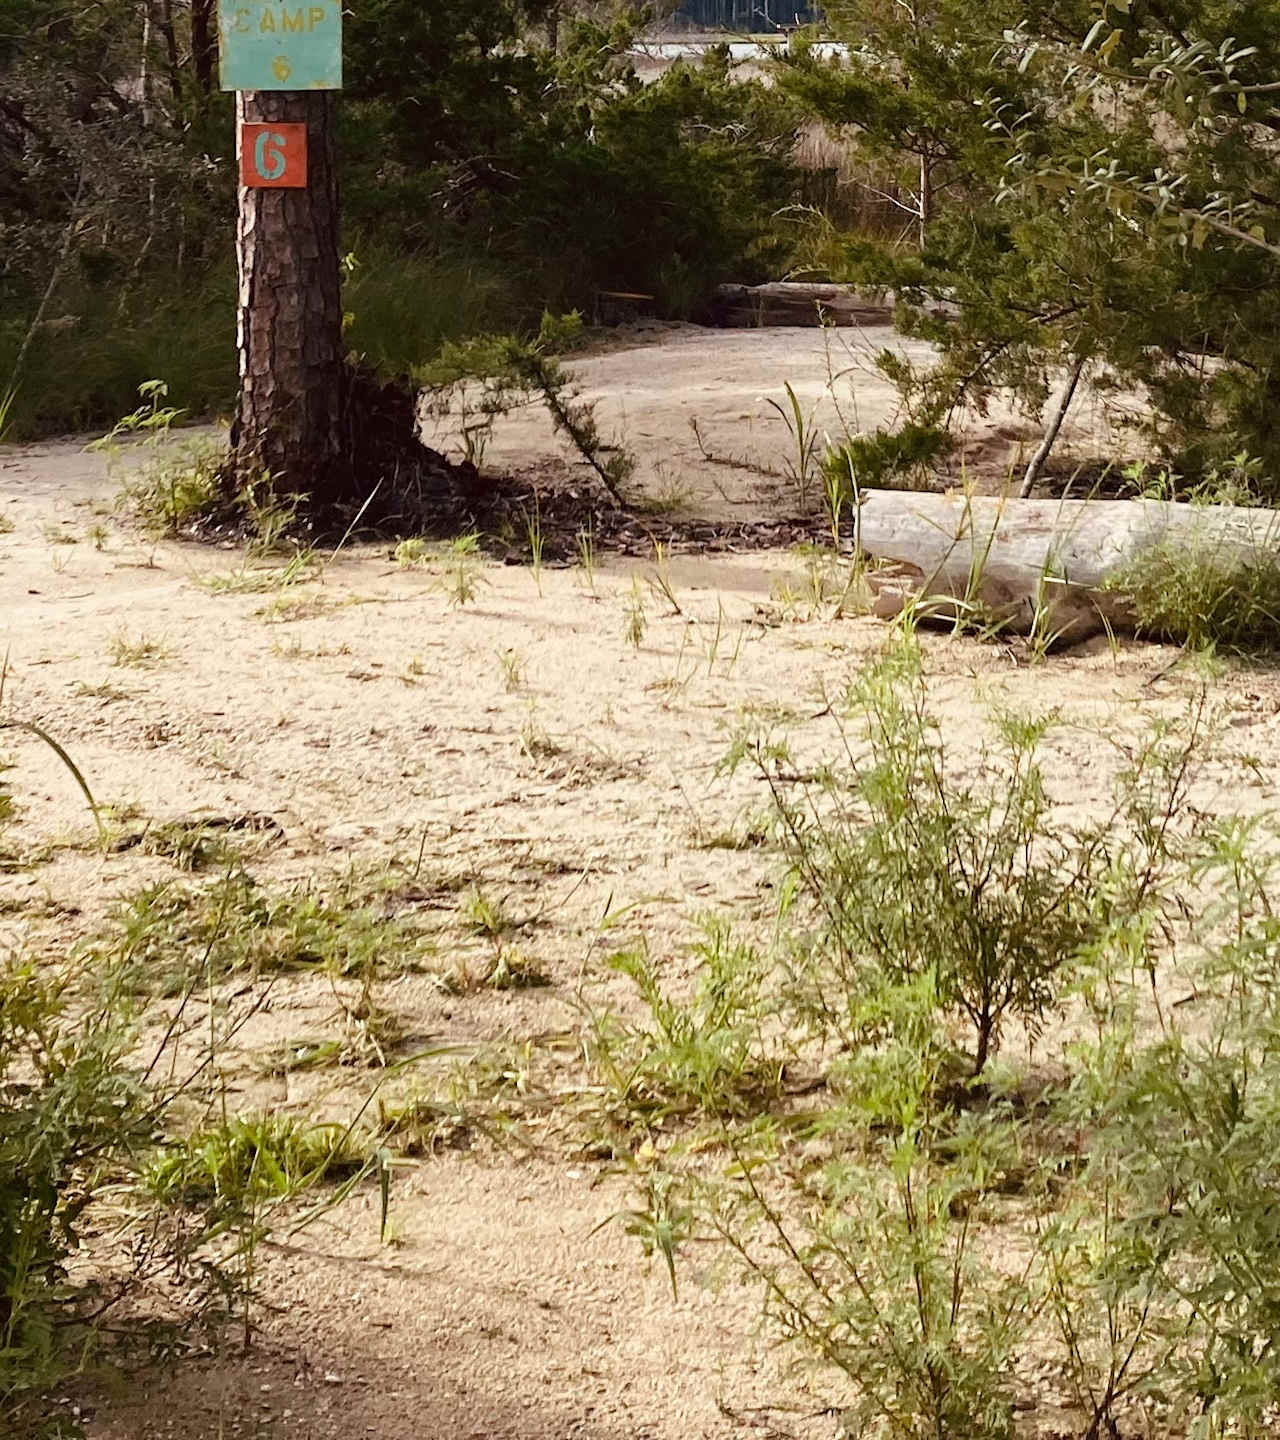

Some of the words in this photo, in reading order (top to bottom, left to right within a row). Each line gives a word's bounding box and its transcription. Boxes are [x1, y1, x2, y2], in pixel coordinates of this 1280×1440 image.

[234, 7, 325, 32] CAMP
[271, 55, 292, 81] 6
[255, 131, 286, 180] 6
